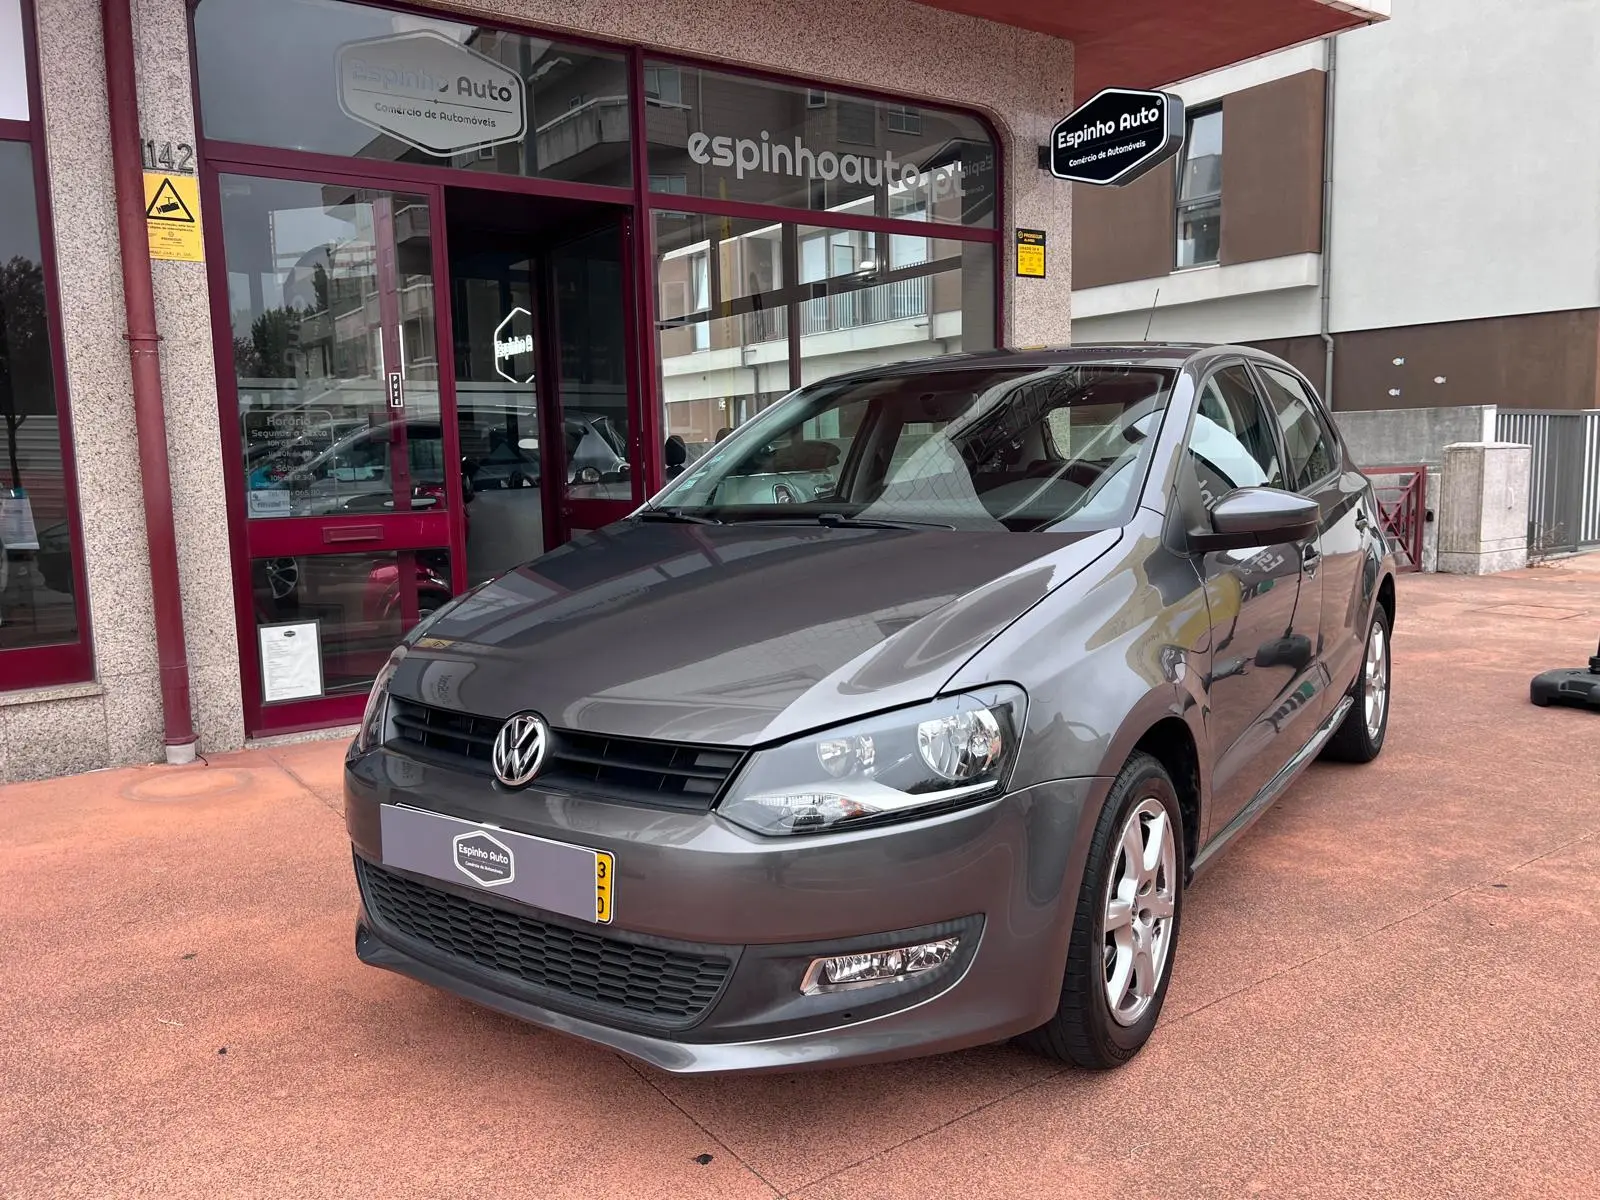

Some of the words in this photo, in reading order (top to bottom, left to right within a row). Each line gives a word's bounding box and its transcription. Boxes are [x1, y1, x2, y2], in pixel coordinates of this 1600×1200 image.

[457, 75, 513, 103] Auto
[374, 102, 422, 119] Comércio
[424, 109, 437, 120] de
[439, 111, 496, 128] Automóveis
[1057, 119, 1116, 149] Espinho
[1119, 105, 1160, 131] Auto
[1069, 151, 1097, 167] Comércio
[1098, 149, 1107, 160] de
[1107, 139, 1146, 158] Automóveis
[687, 130, 967, 203] espinhoauto.pt
[266, 415, 311, 427] Horário
[458, 843, 488, 859] Espinho
[489, 851, 509, 864] Auto
[598, 862, 606, 878] 3
[598, 897, 605, 914] 0
